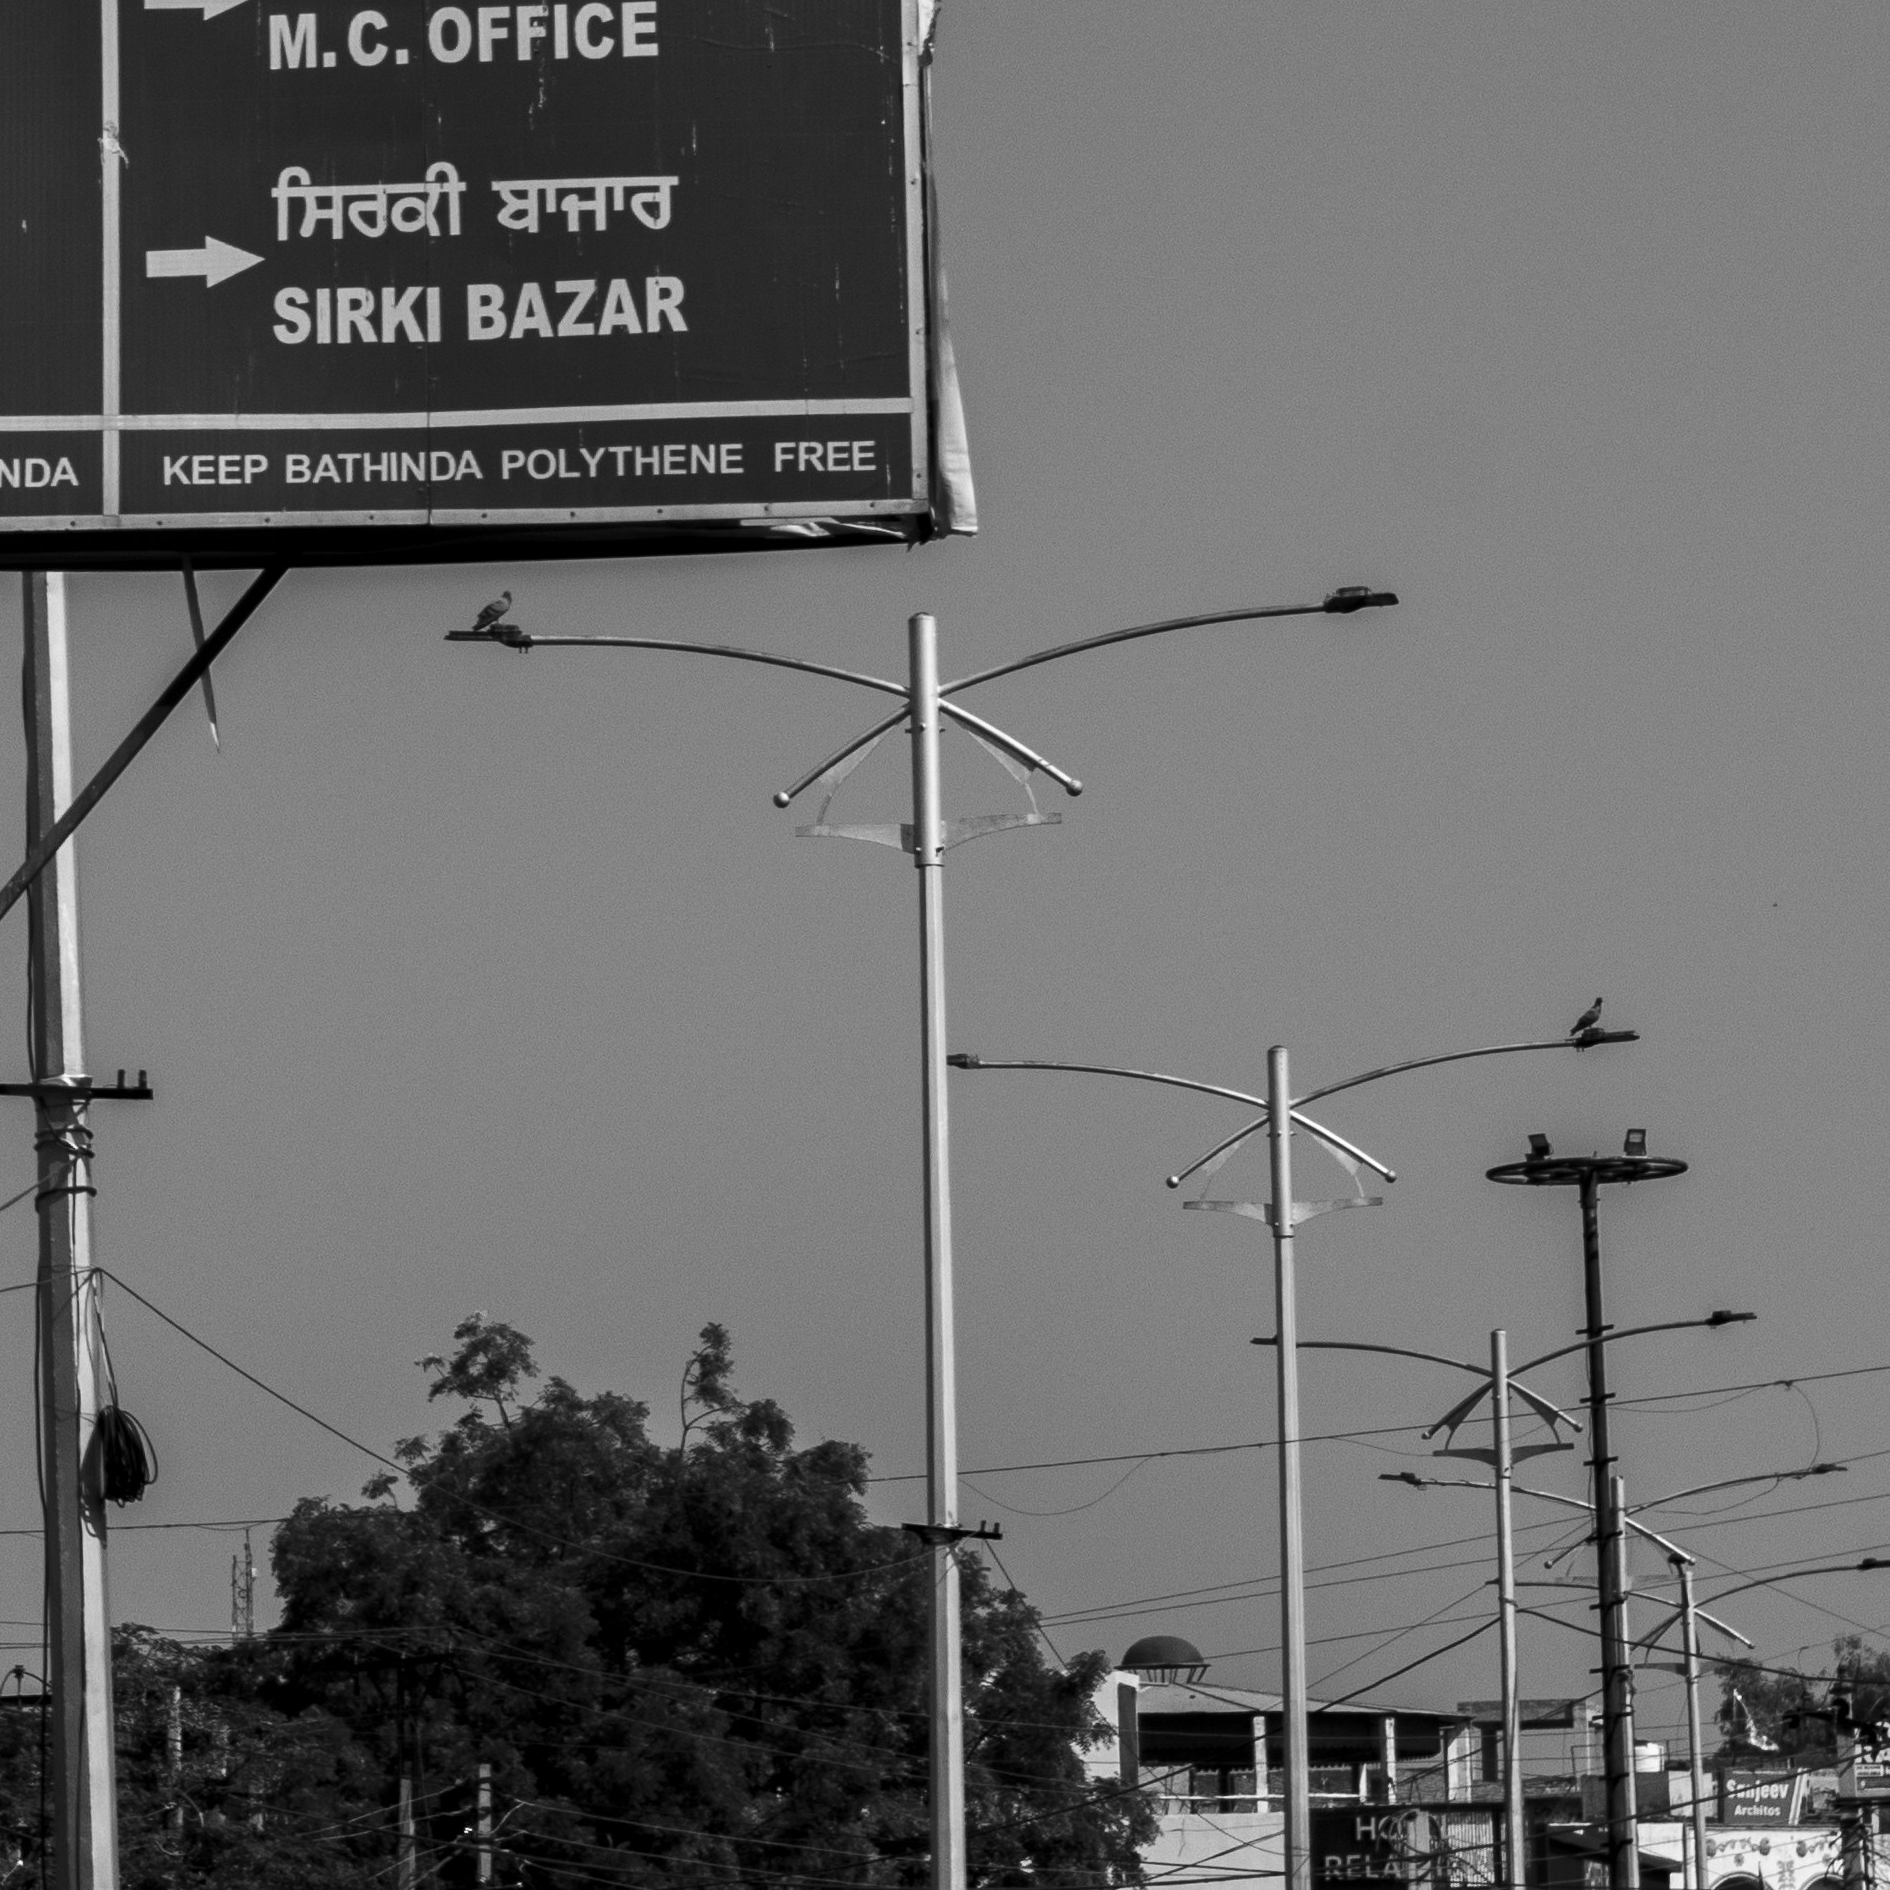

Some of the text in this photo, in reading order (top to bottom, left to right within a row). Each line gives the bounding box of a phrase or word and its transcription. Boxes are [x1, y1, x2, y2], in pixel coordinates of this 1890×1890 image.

[429, 1, 658, 63] OFFICE
[272, 162, 678, 241] ਸਿਰਕੀ ਬਾਜਾਰ
[273, 276, 687, 345] SIRKI BAZAR
[164, 441, 876, 486] KEEP BATHINDA POLYTHENE FREE
[1726, 1779, 1790, 1802] Sanjeev
